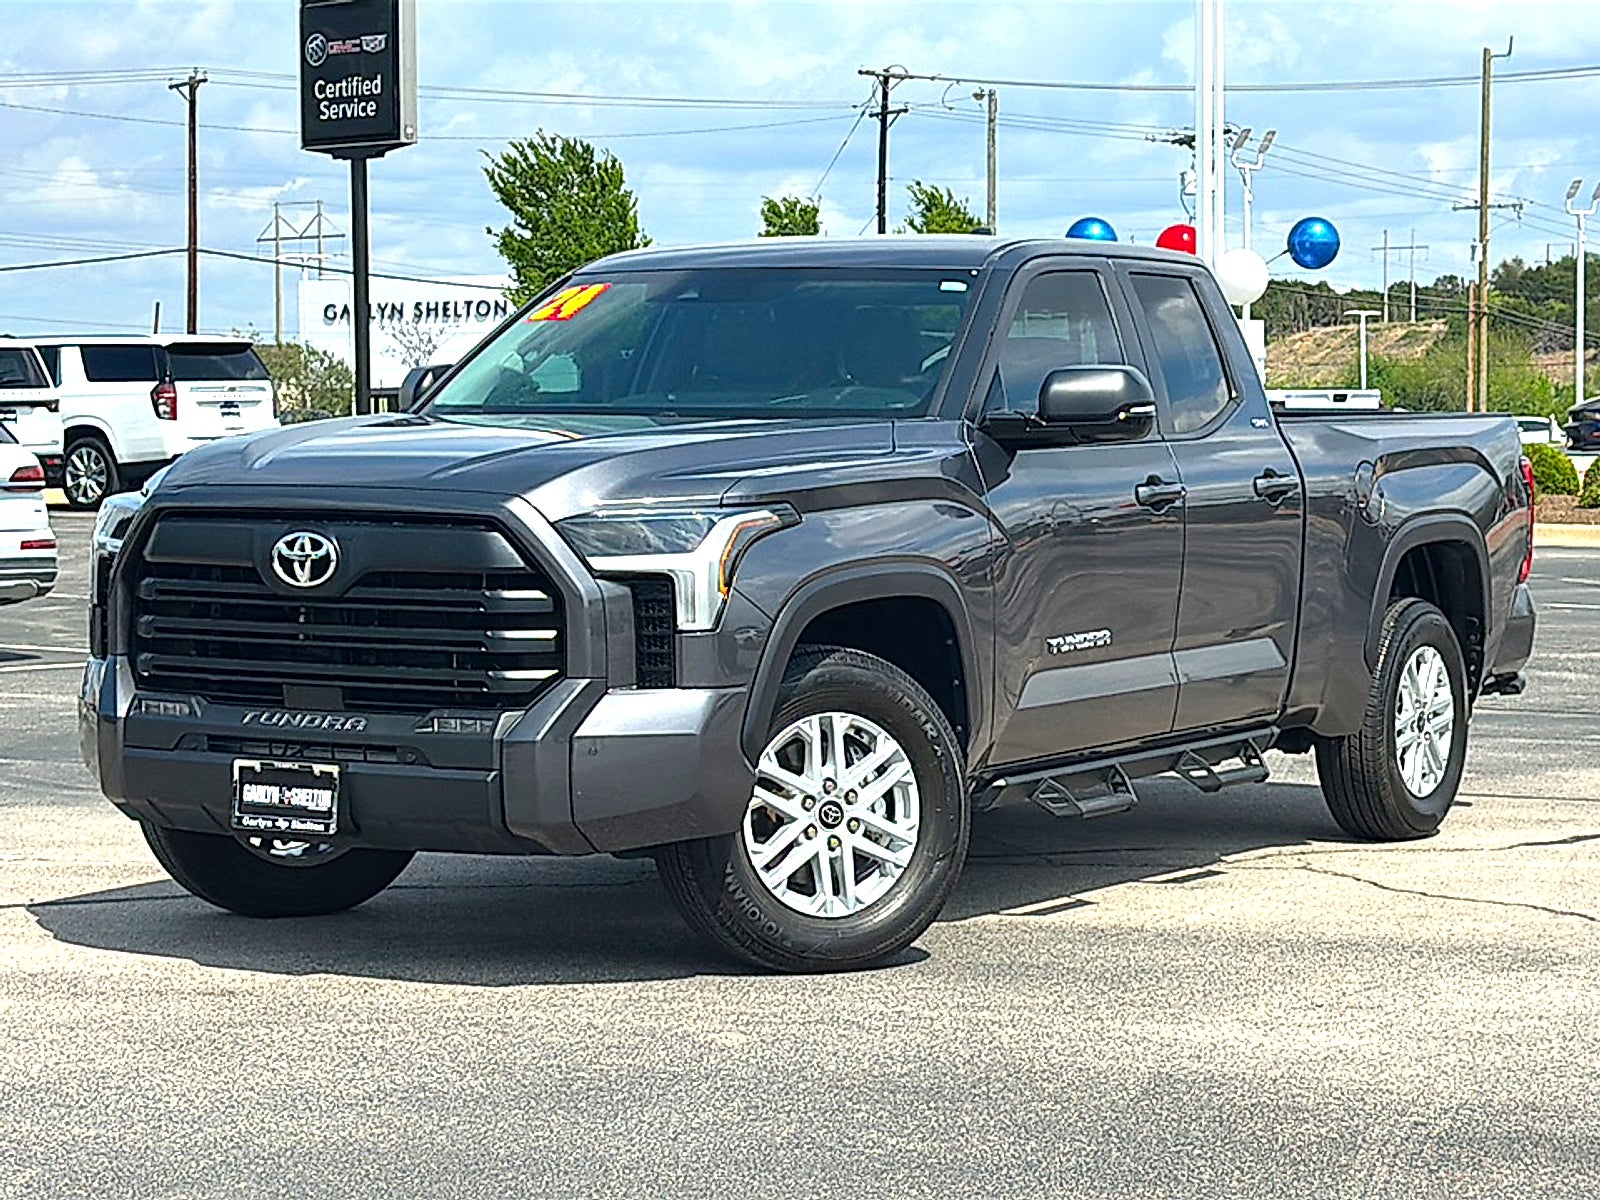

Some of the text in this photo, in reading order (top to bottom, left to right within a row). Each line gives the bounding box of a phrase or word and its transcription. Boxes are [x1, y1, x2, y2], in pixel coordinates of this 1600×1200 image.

[314, 73, 382, 99] Certified
[319, 98, 377, 120] Service
[323, 300, 508, 321] GALYN SHELTON
[1046, 629, 1111, 655] TUNDRA
[242, 710, 367, 732] TUNDRA
